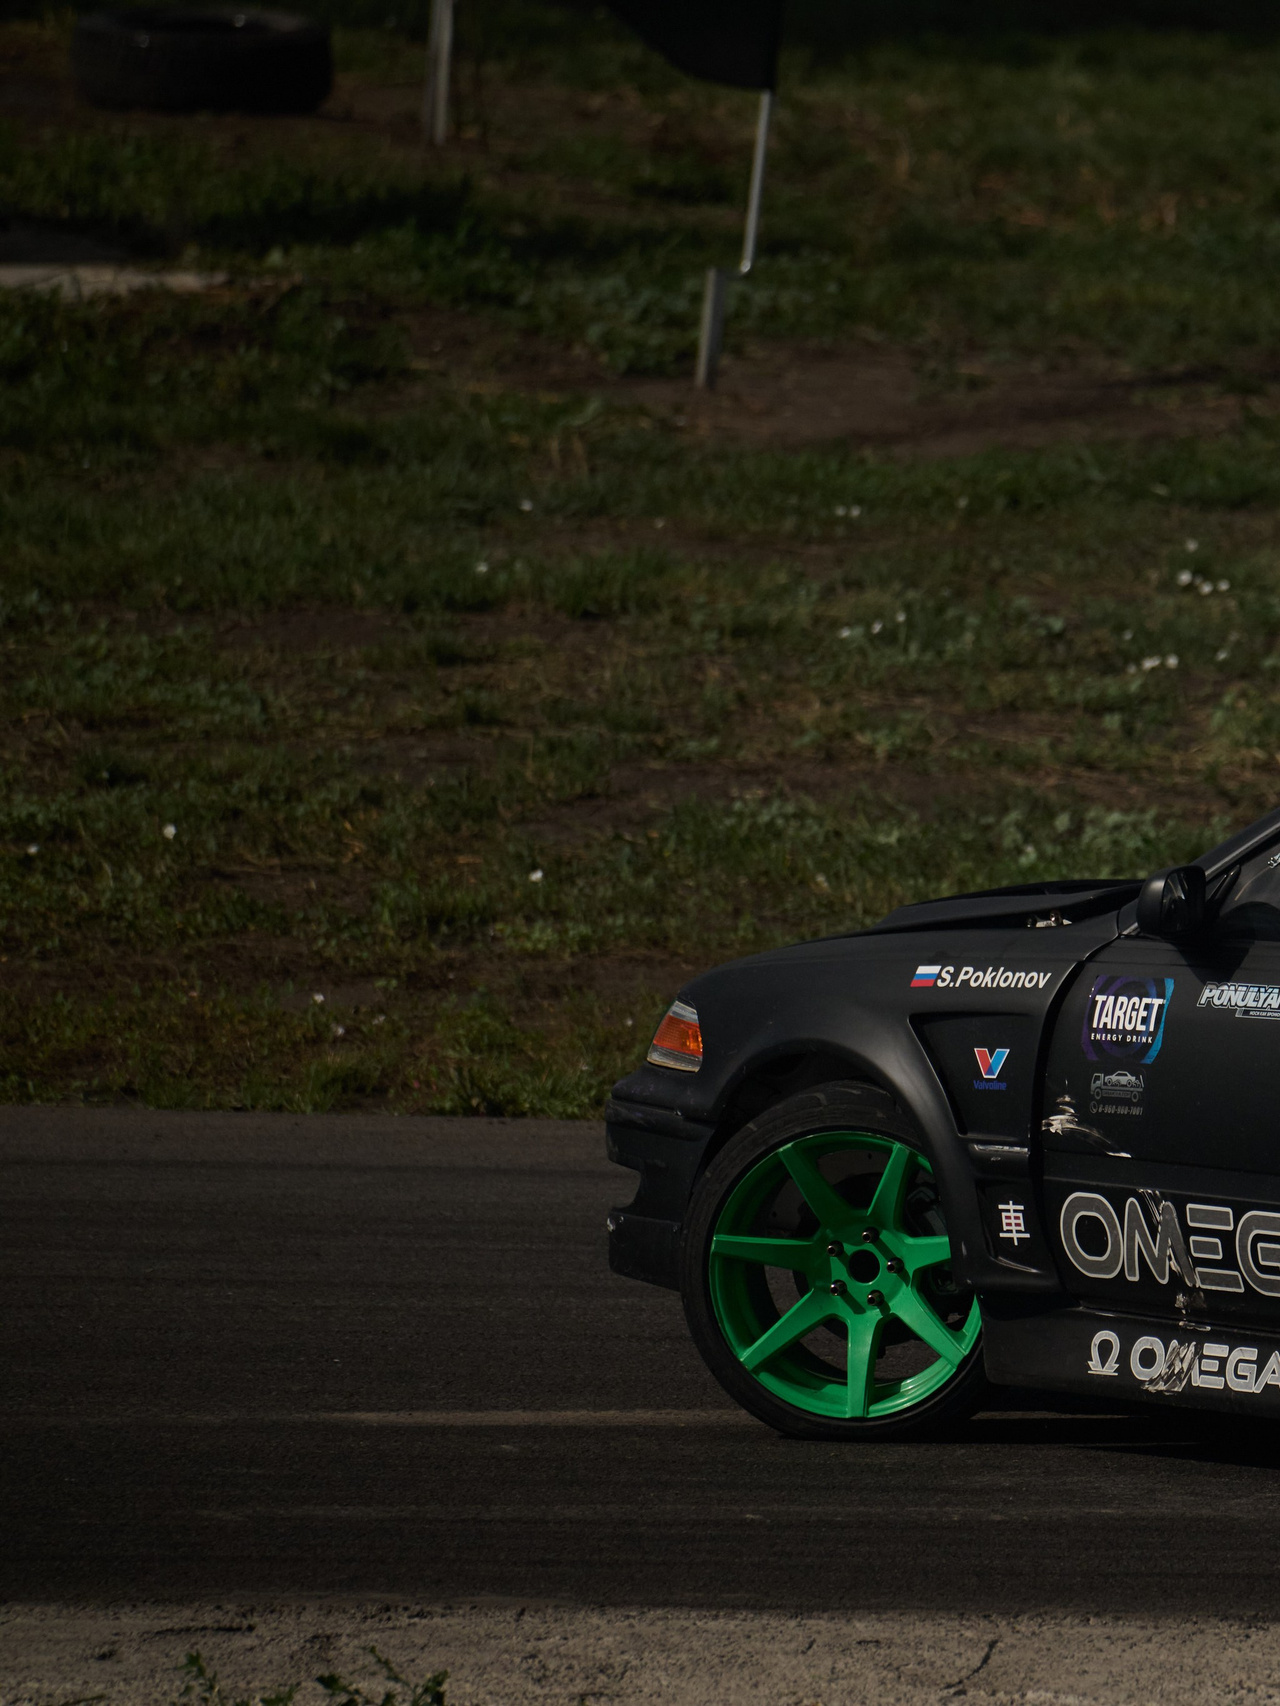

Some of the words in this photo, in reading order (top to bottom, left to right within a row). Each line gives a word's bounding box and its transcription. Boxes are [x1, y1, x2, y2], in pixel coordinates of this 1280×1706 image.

[937, 966, 1052, 990] S.Poklonov
[1092, 994, 1164, 1032] TARGET
[1090, 1033, 1123, 1042] ENERGY
[1126, 1035, 1153, 1043] DRINK
[973, 1080, 1007, 1090] Valvoline
[998, 1200, 1030, 1246] 車
